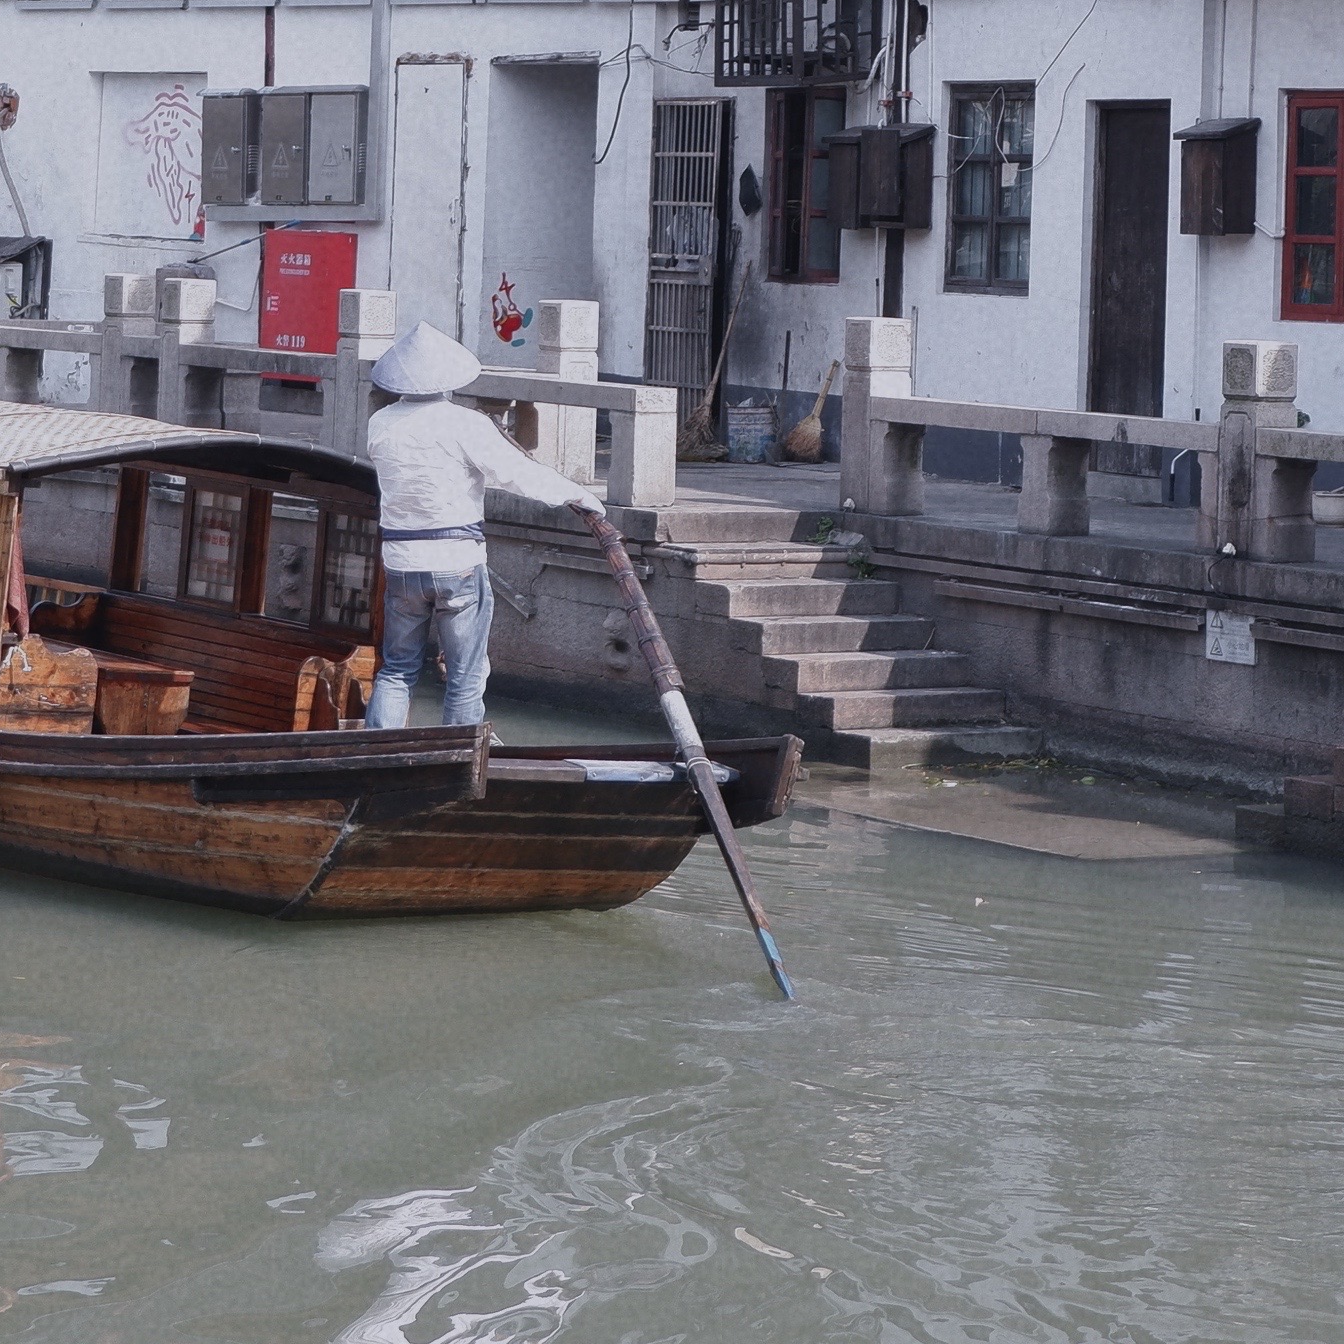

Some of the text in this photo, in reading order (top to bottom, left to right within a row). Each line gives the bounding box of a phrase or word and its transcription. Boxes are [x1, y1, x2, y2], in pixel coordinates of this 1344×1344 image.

[280, 253, 312, 266] 灭火器箱
[276, 334, 306, 348] 火警 119
